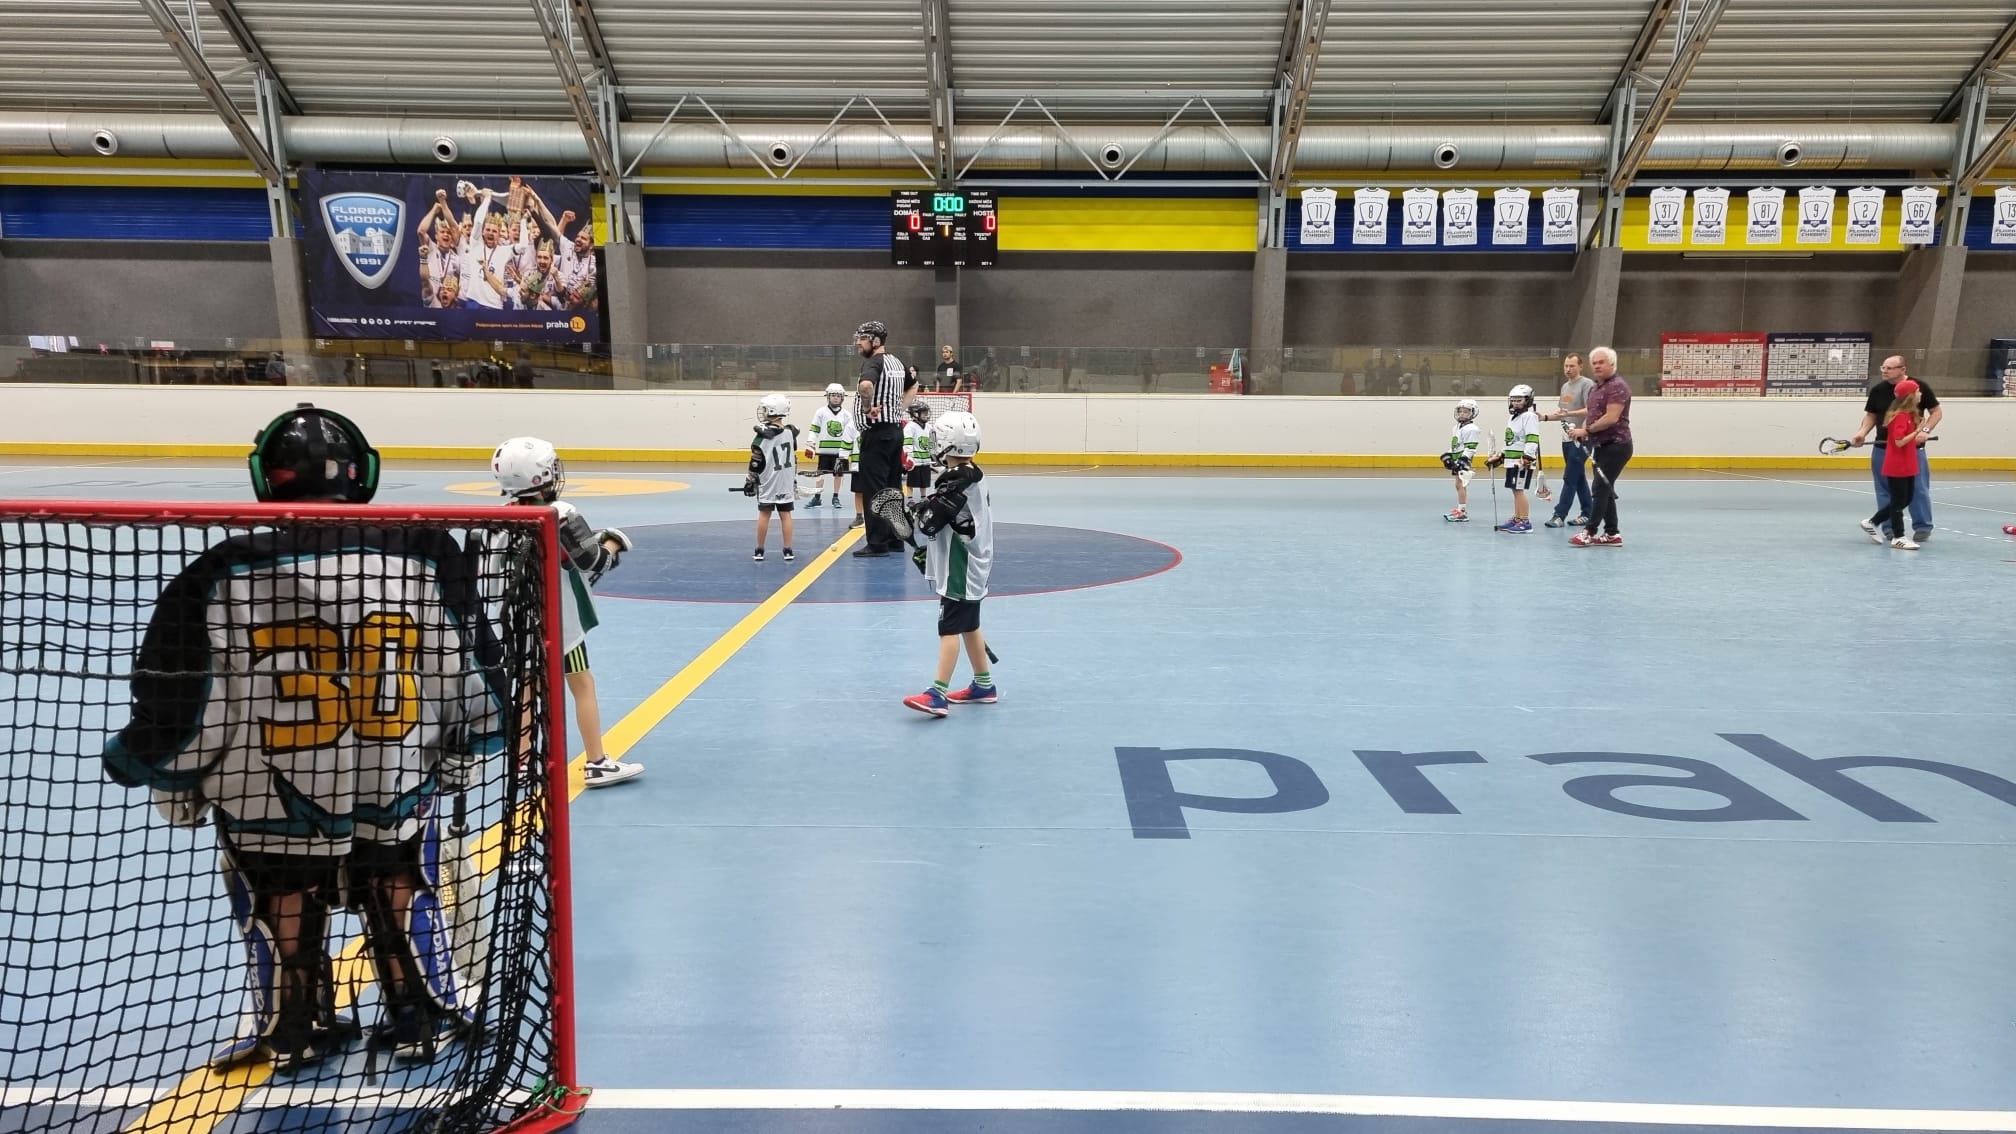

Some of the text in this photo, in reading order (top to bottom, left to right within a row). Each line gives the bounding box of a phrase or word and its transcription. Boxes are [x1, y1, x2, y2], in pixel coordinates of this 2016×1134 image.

[331, 206, 396, 216] FLORBAL
[934, 197, 964, 212] 0:00
[1316, 205, 1322, 218] 11
[1369, 204, 1374, 218] 8
[1662, 204, 1671, 218] 31
[1705, 204, 1714, 219] 31
[1761, 204, 1770, 218] 81
[1814, 204, 1818, 217] 9
[1863, 204, 1868, 218] 2
[1914, 204, 1924, 218] 66
[1418, 205, 1422, 219] 3
[1455, 206, 1465, 220] 24
[1509, 205, 1514, 219] 7
[1556, 205, 1566, 219] 90
[336, 215, 392, 224] CHODOV
[911, 215, 920, 229] 0
[987, 216, 995, 230] 0
[945, 225, 948, 236] 1
[546, 320, 569, 329] praha
[772, 442, 792, 471] 17
[248, 610, 420, 756] 30
[1114, 732, 2016, 840] prah
